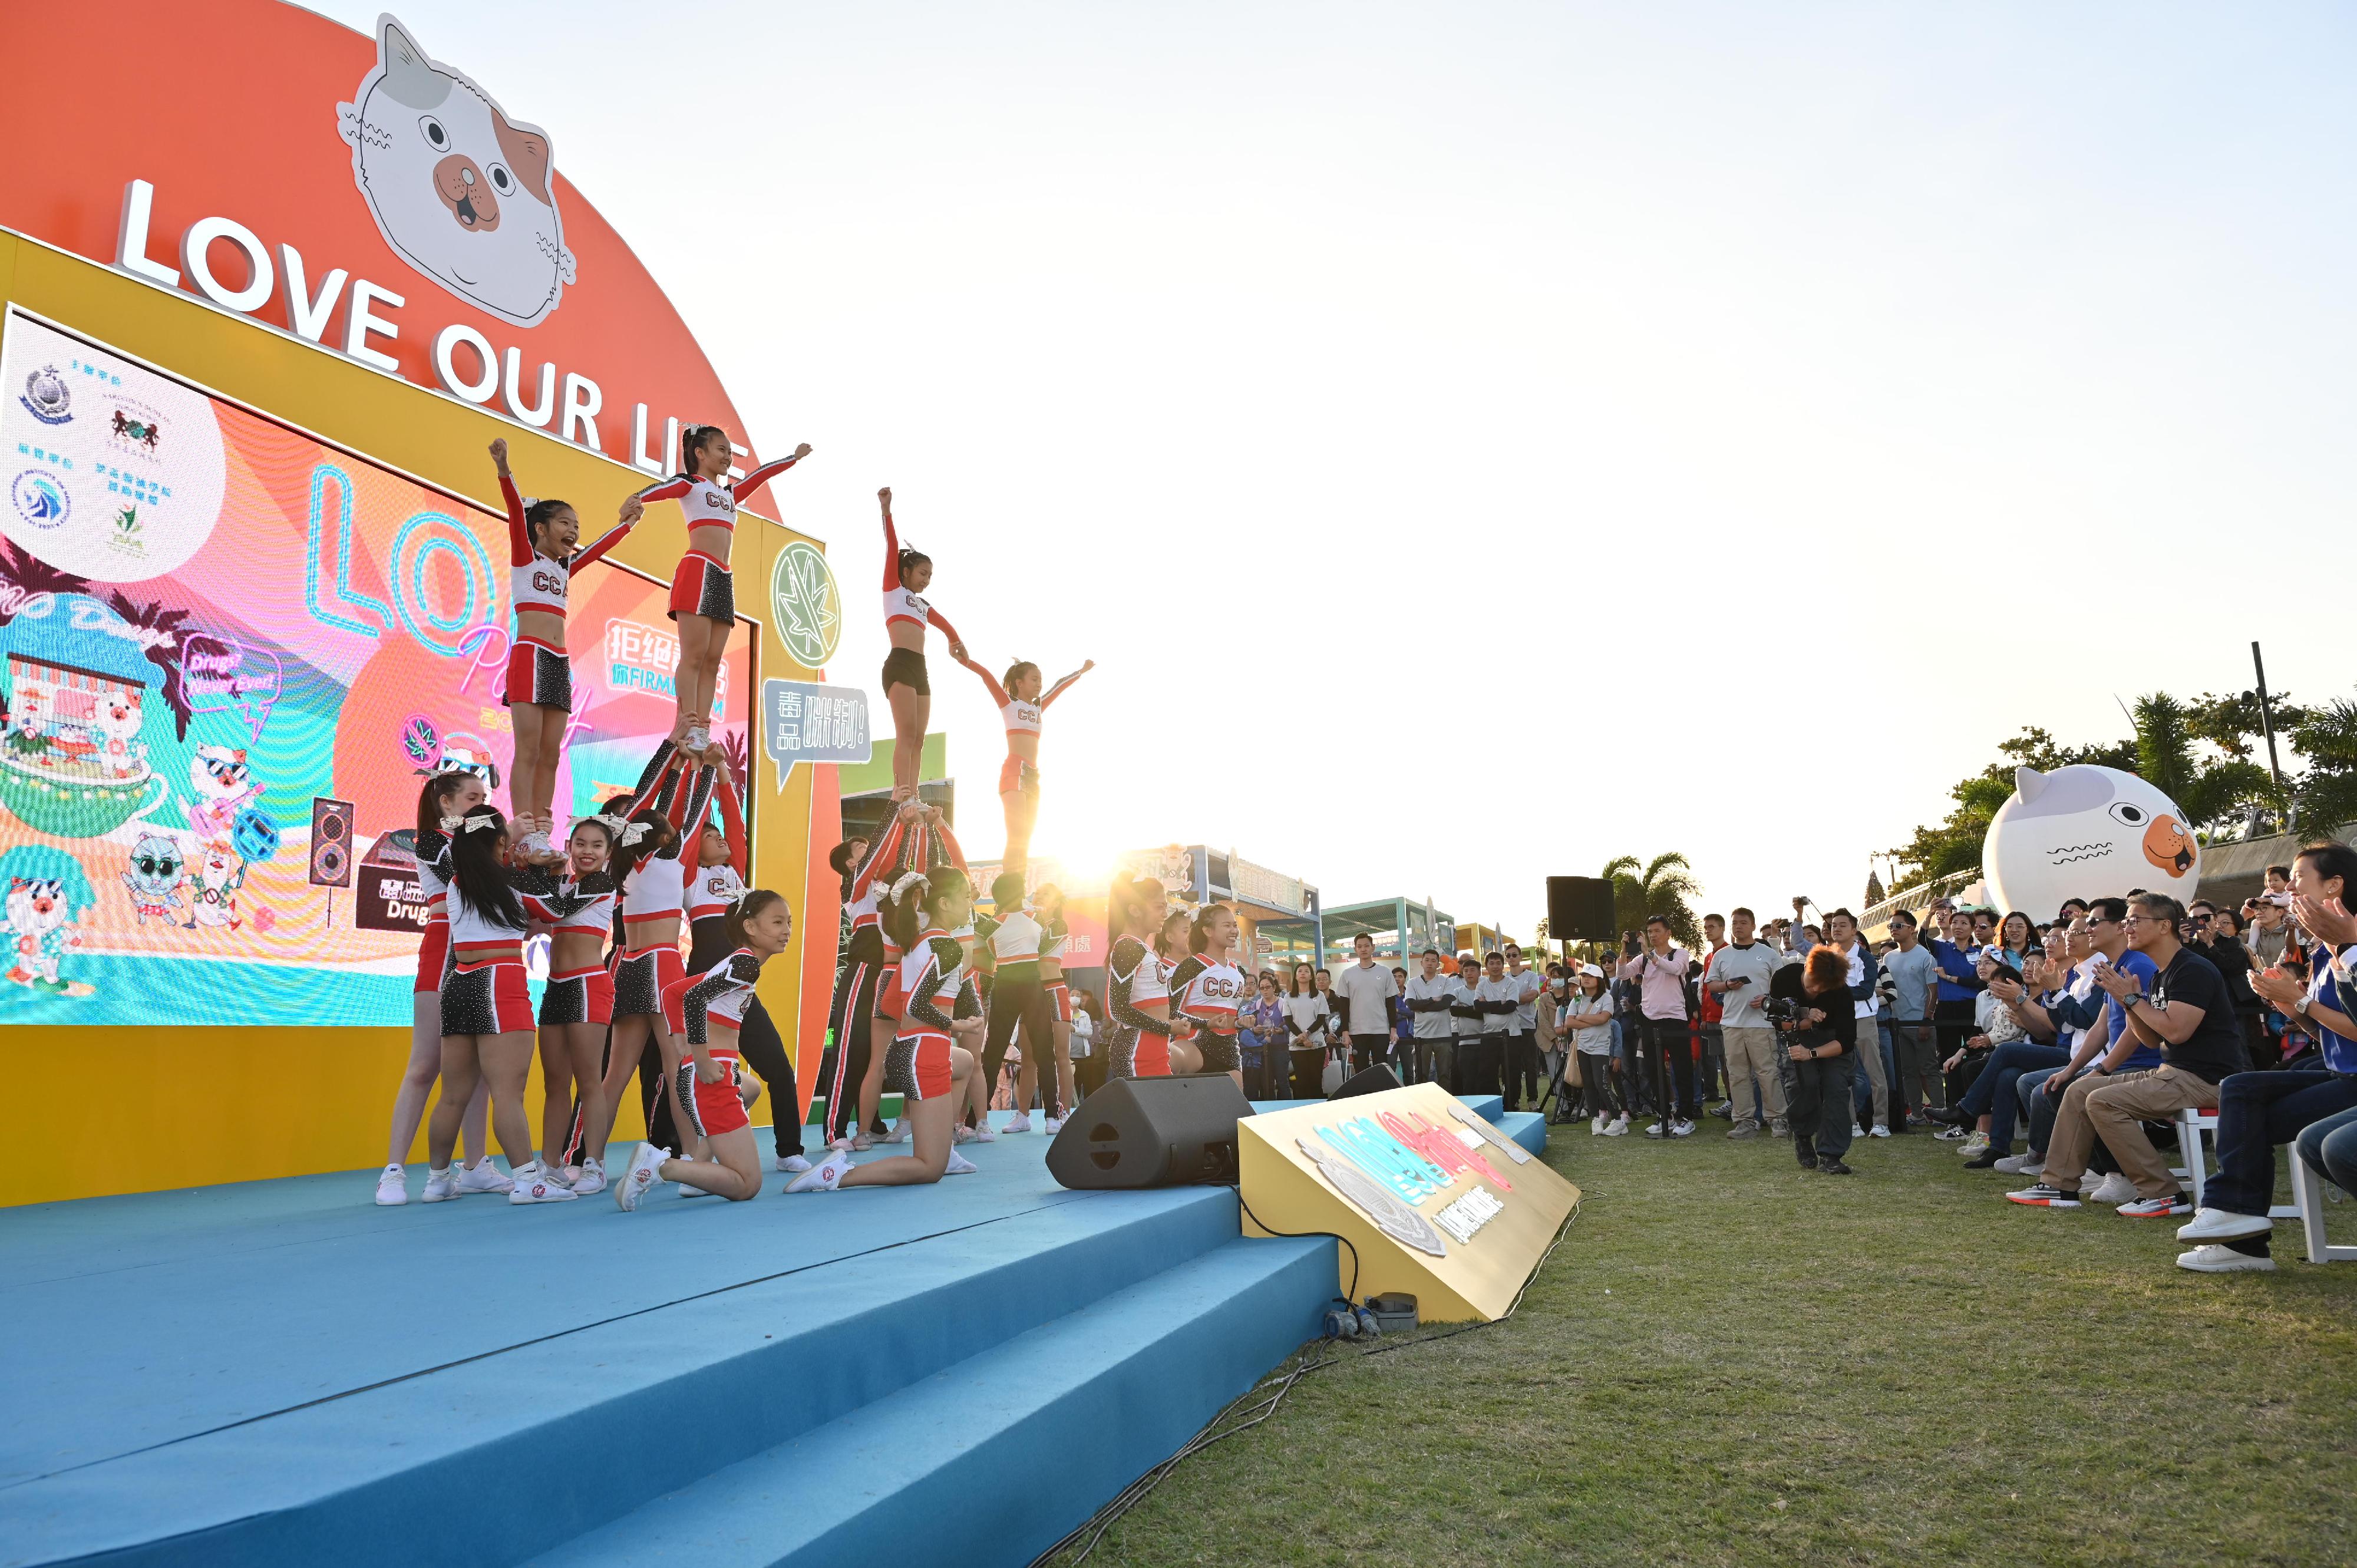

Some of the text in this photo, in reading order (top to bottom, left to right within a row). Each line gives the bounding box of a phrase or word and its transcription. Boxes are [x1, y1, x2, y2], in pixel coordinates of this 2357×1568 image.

[121, 179, 749, 489] LOVE OUR LIE
[306, 464, 520, 656] LO
[777, 691, 864, 750] 毒品 咪制!
[387, 900, 430, 926] Drug
[1203, 976, 1245, 999] CCA
